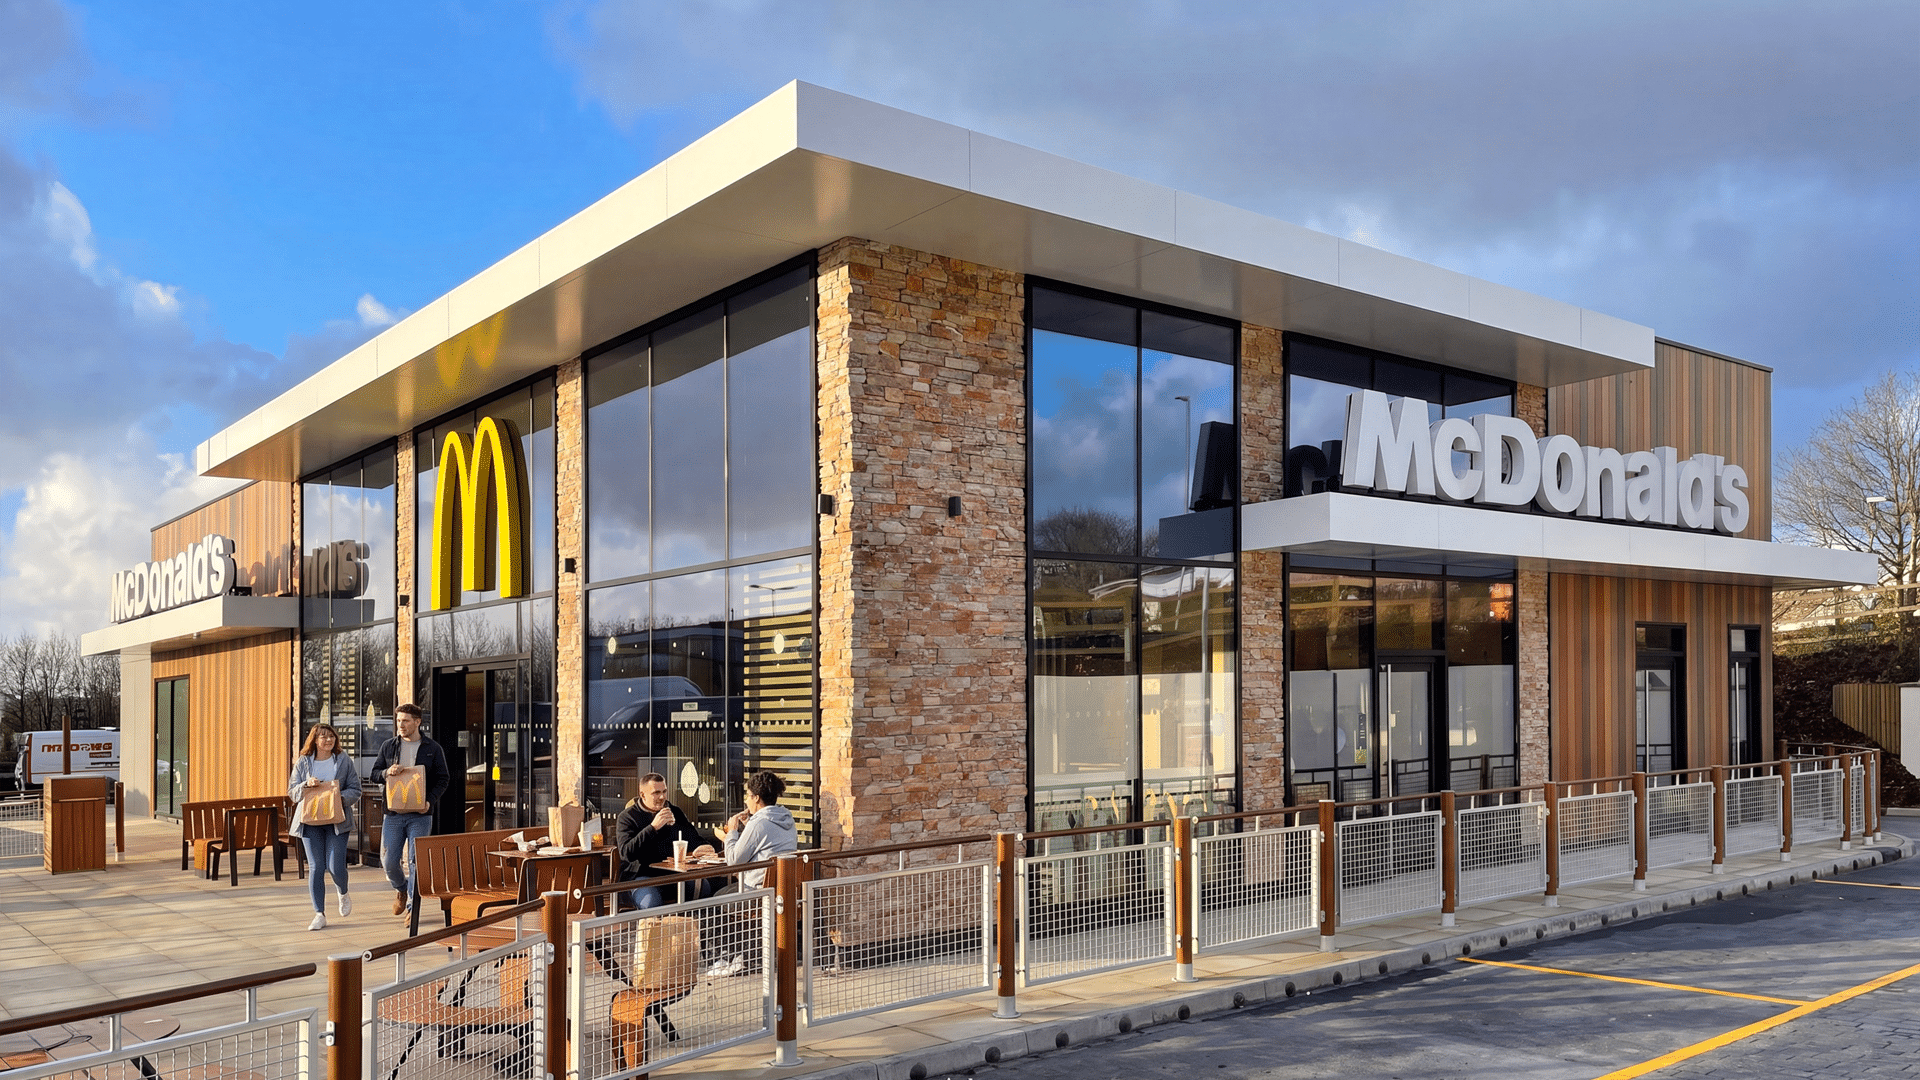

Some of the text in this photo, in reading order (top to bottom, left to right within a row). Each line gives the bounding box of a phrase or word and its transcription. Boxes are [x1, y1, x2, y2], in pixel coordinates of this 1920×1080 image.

[431, 416, 522, 611] M
[1342, 389, 1749, 533] McDonald's
[111, 534, 230, 624] McDonald's
